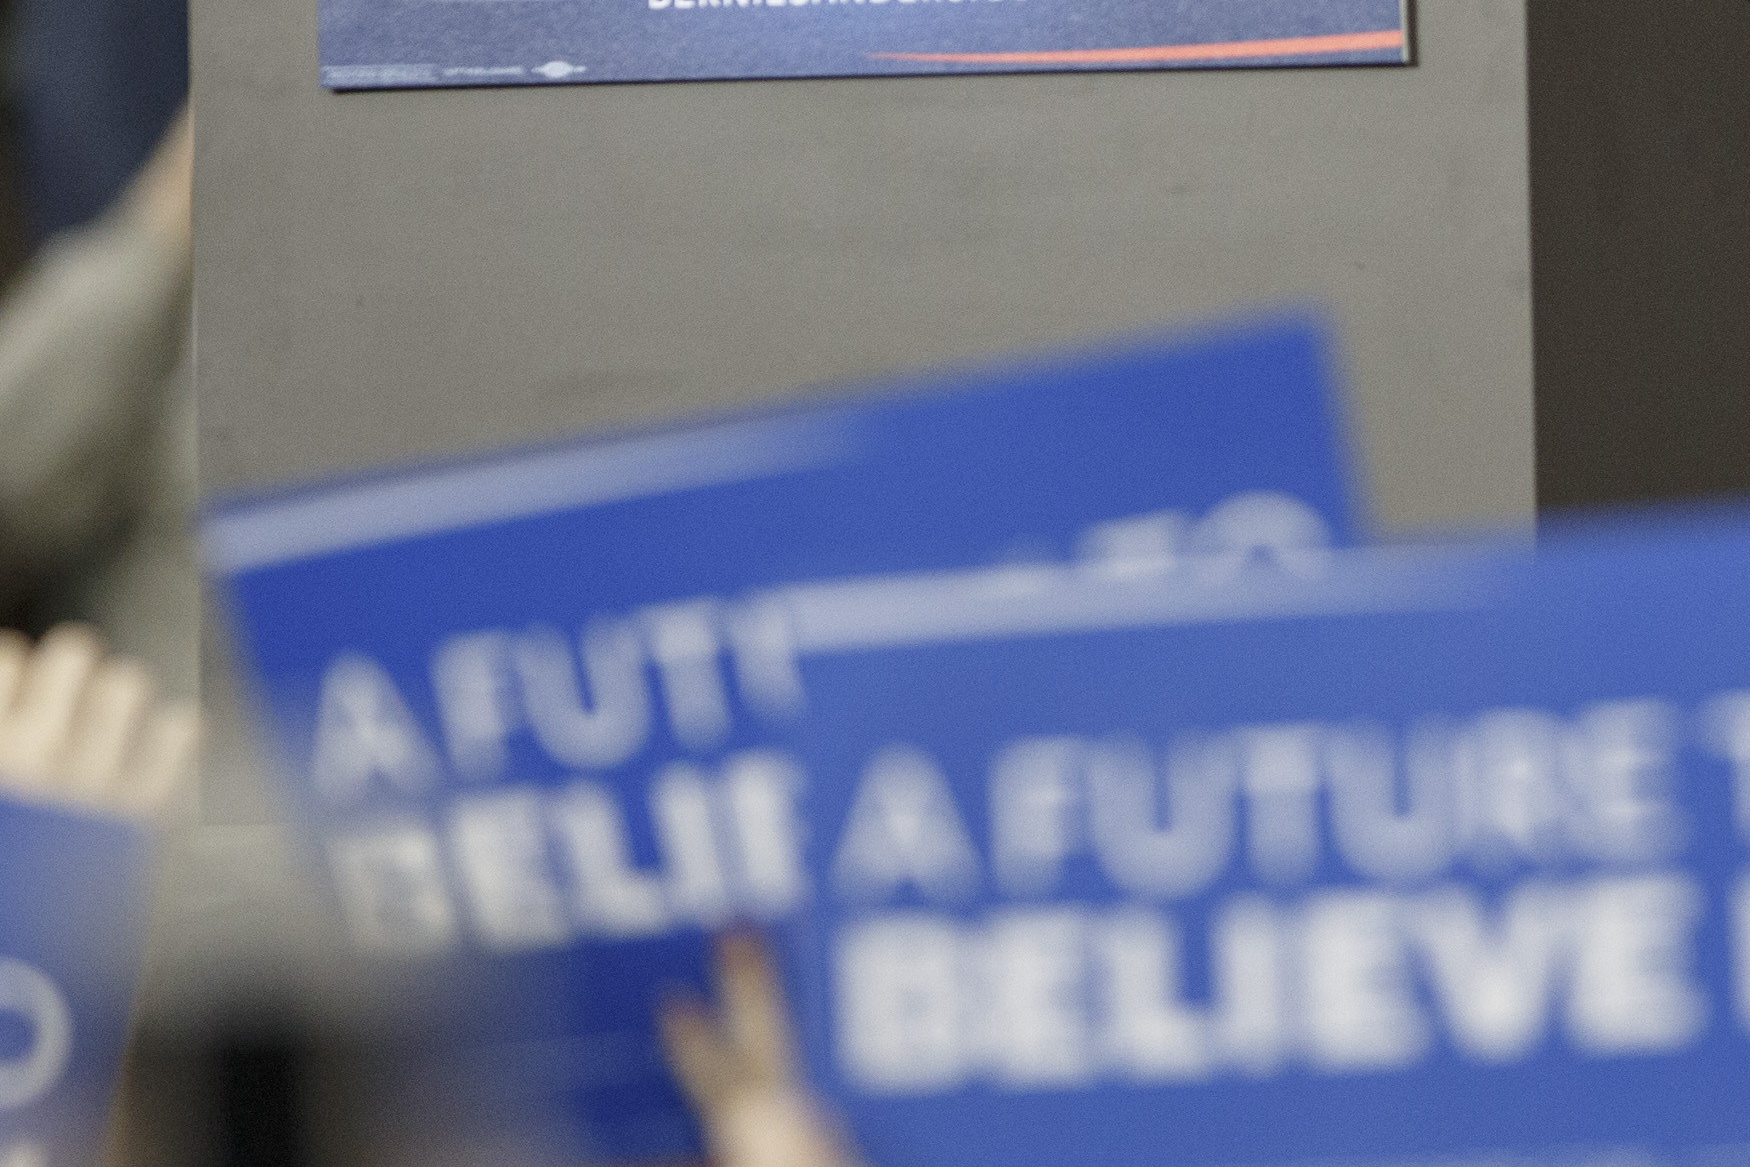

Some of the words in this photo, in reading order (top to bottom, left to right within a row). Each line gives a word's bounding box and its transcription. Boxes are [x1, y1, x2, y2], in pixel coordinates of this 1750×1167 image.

[313, 647, 434, 802] A
[828, 741, 983, 903] A
[988, 696, 1690, 901] FUTURE
[835, 872, 1700, 1093] BELIEVE
